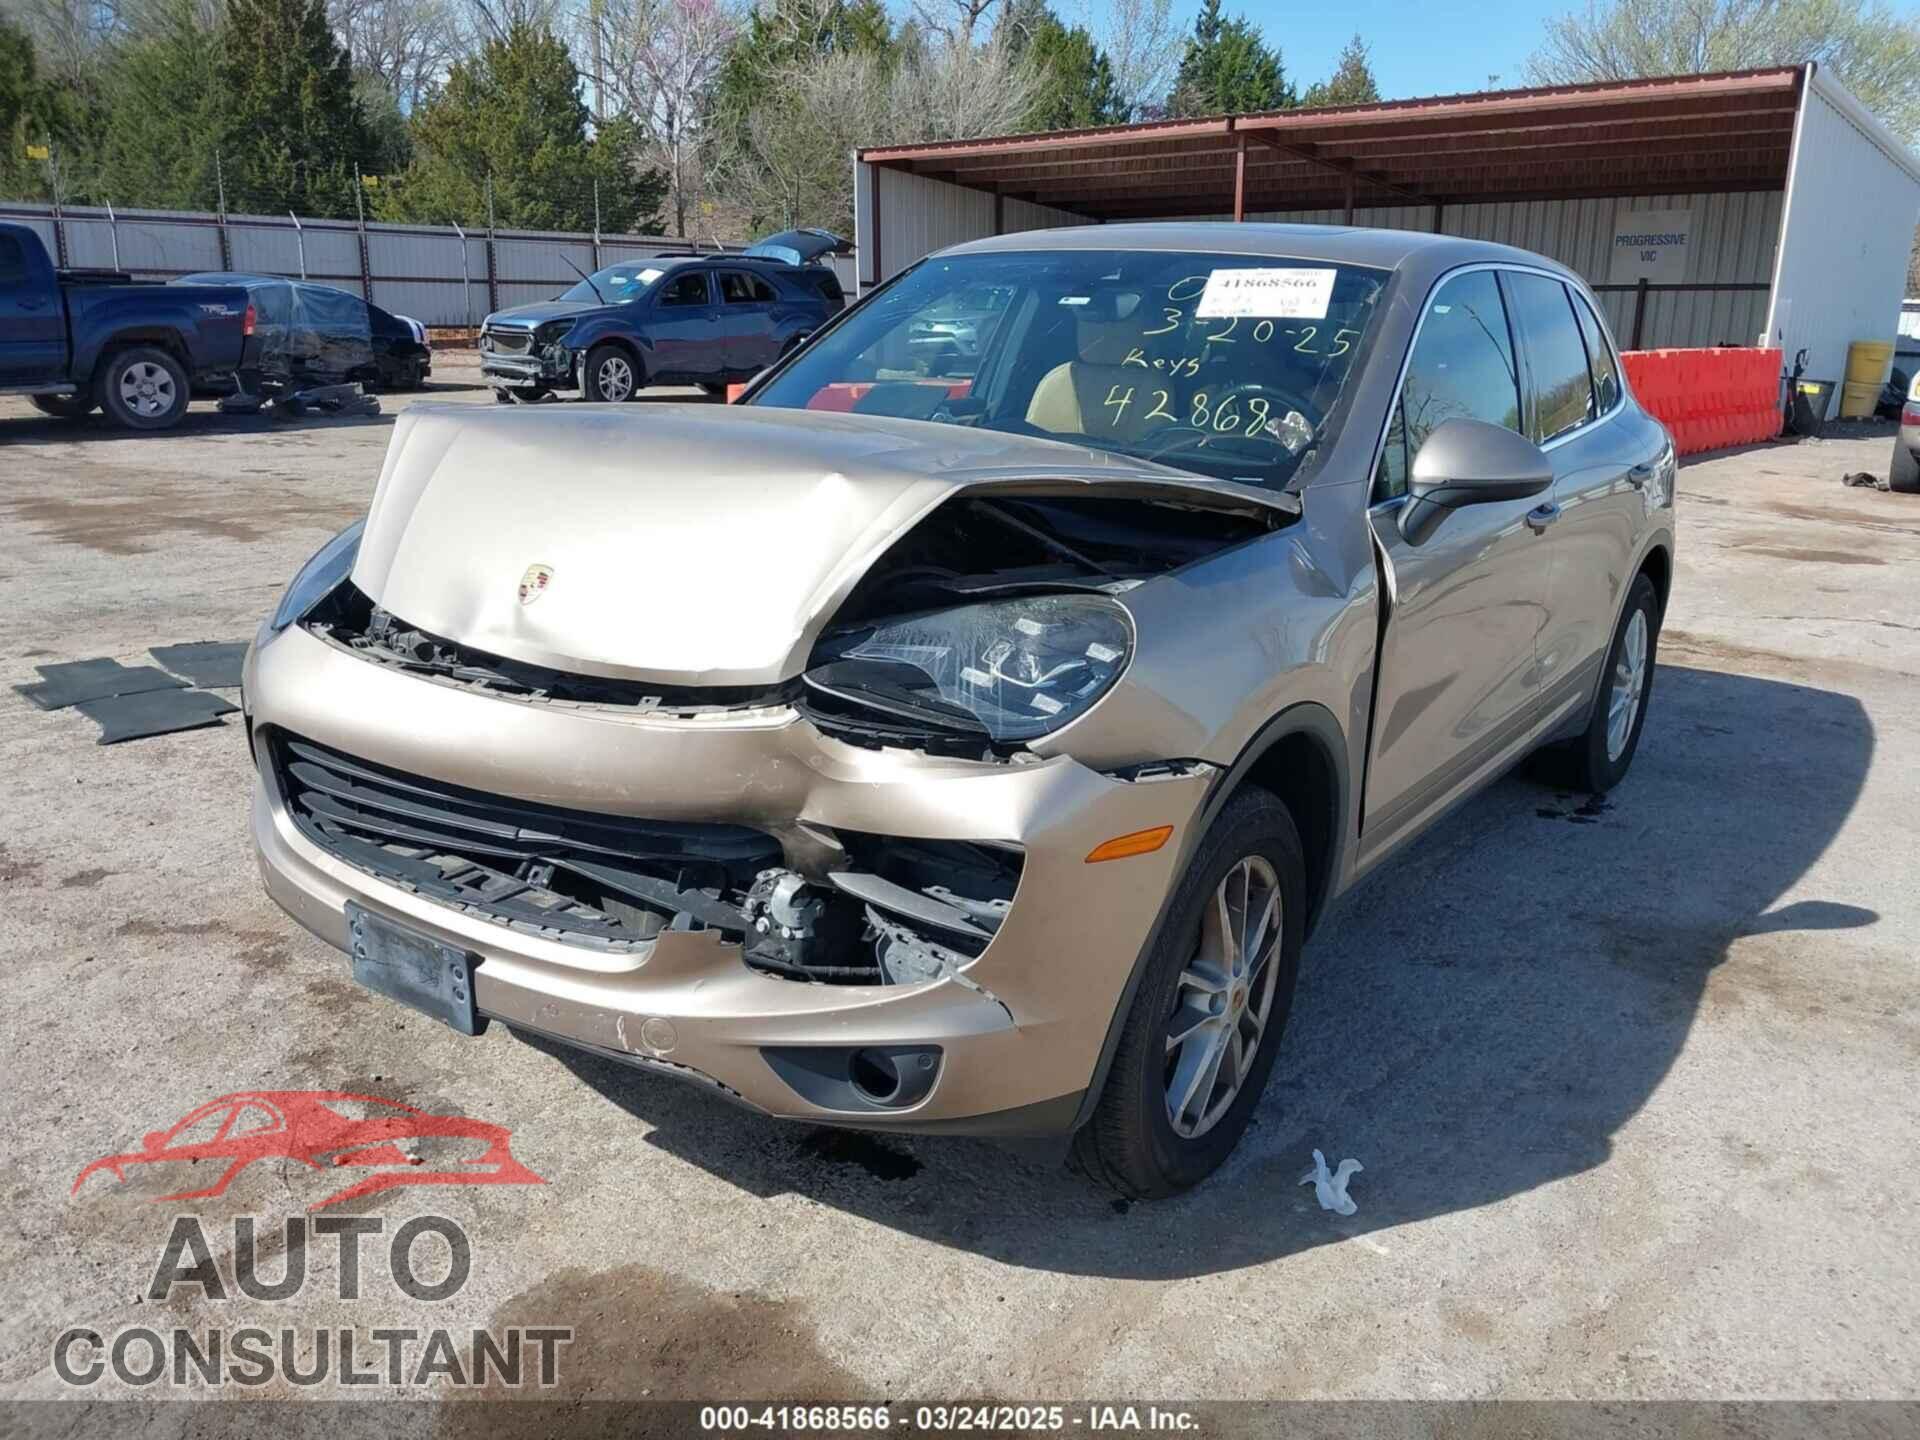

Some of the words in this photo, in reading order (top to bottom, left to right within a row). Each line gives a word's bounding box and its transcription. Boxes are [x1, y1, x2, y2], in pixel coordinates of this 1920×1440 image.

[1615, 233, 1688, 247] PROGRESSIVE
[1640, 251, 1656, 262] VIC
[1121, 347, 1200, 377] Keys
